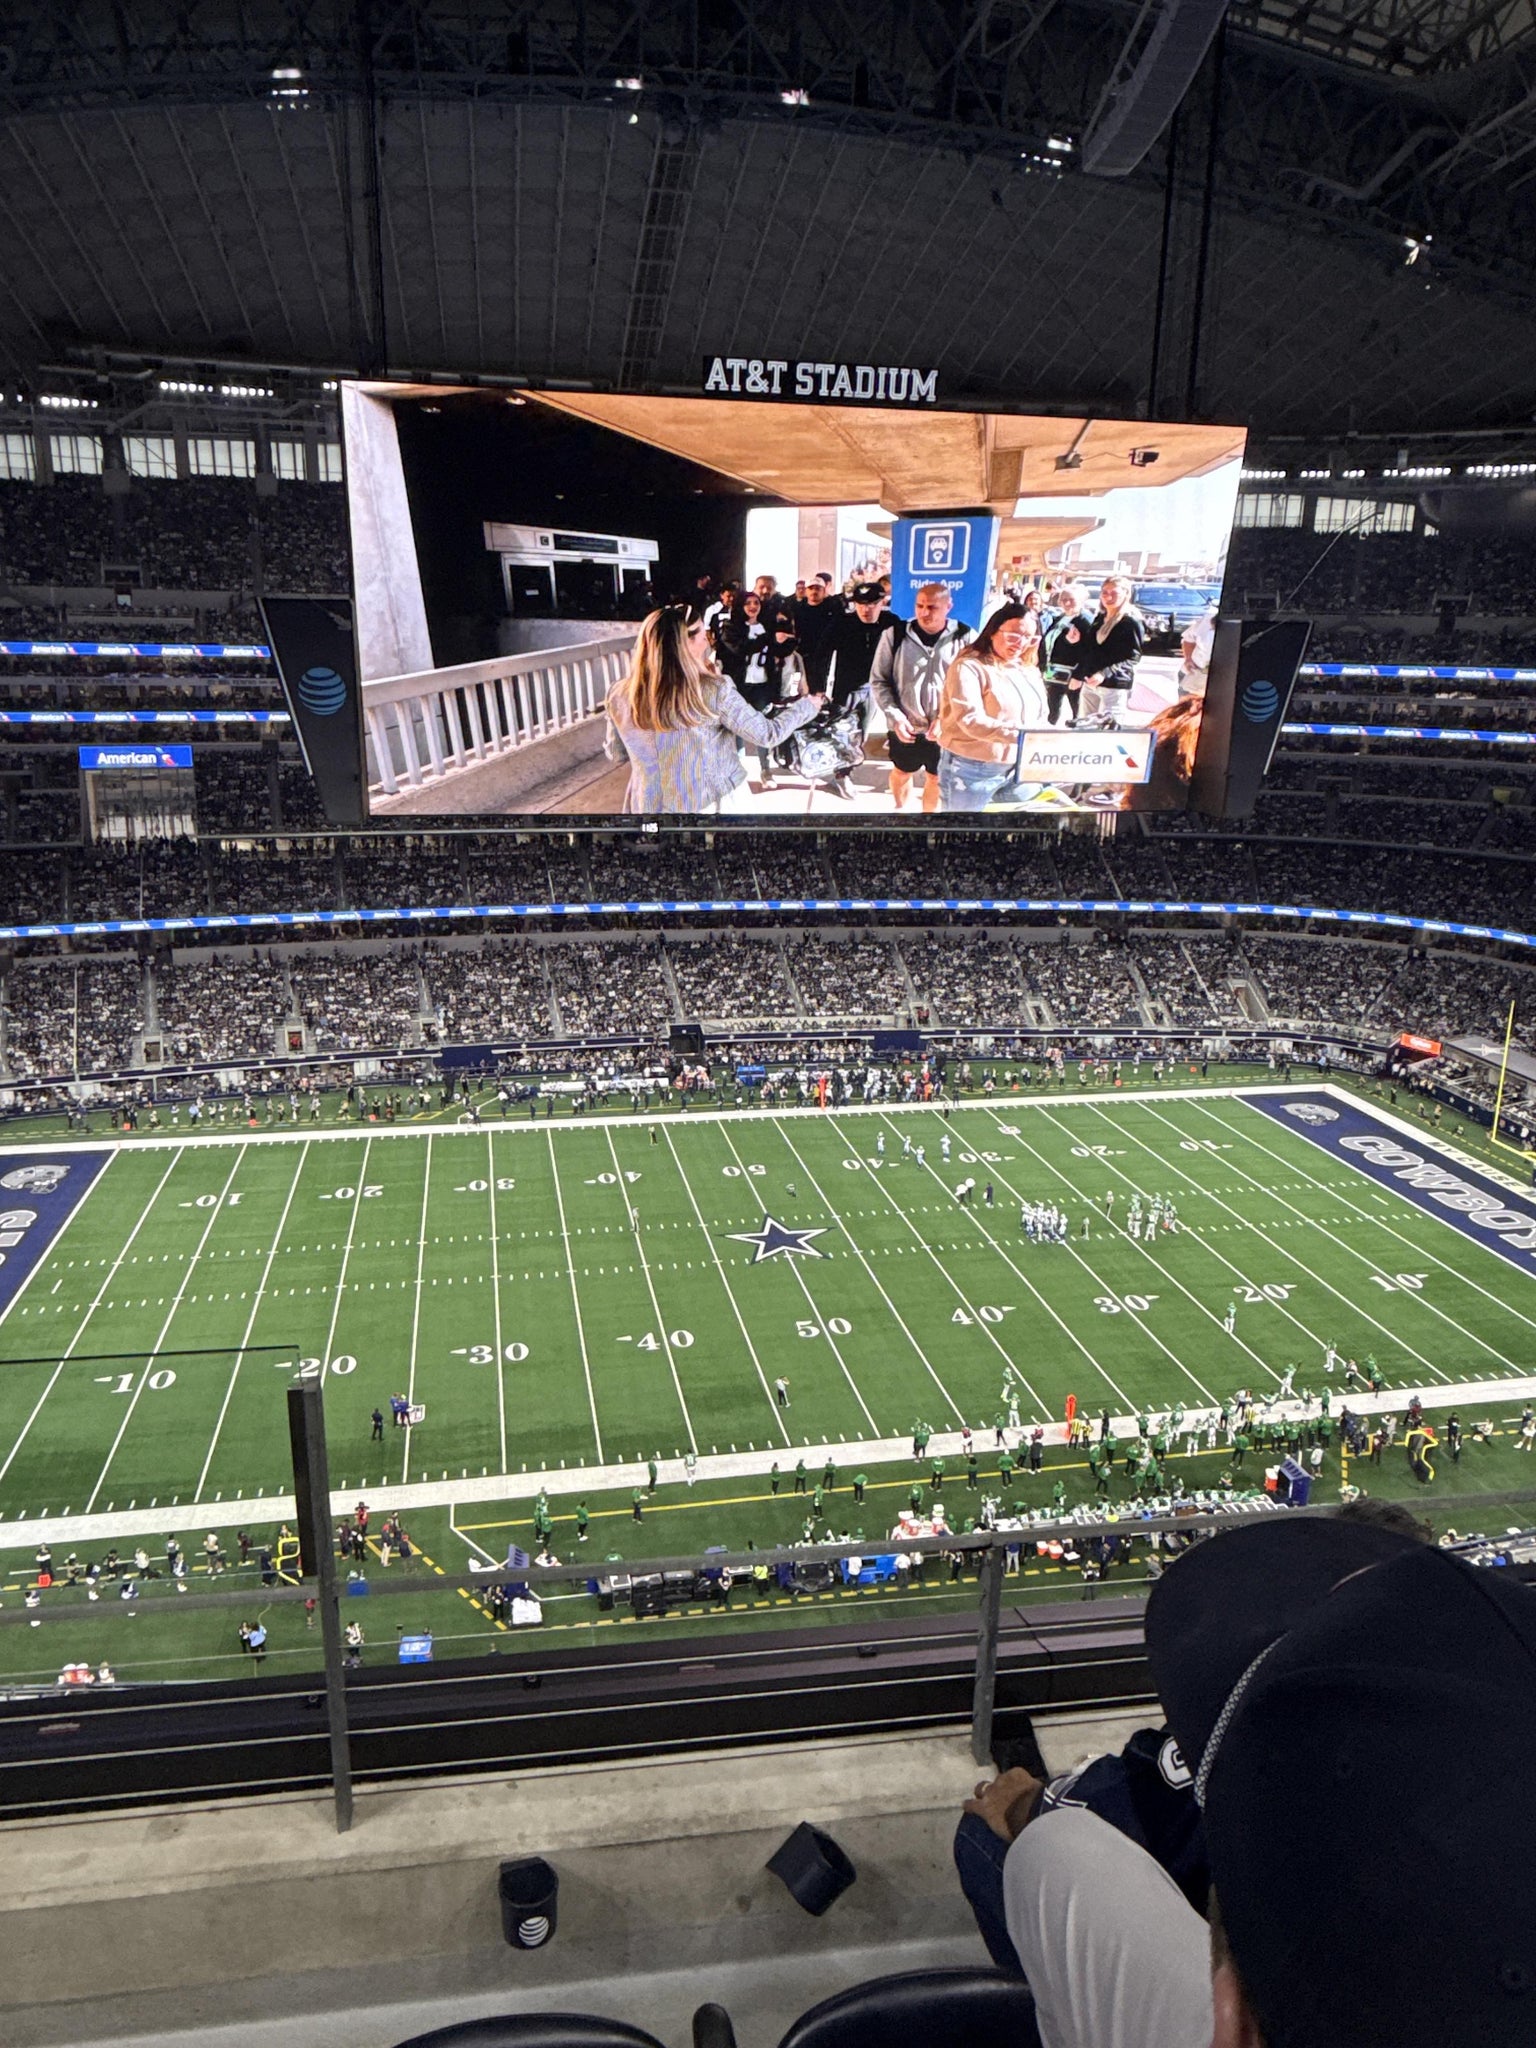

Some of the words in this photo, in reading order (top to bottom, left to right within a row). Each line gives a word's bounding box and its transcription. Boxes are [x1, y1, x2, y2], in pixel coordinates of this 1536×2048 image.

[705, 357, 788, 395] AT&T
[795, 362, 939, 402] STADIUM
[97, 752, 157, 765] American
[1029, 751, 1112, 765] American
[1339, 1136, 1536, 1258] COWBOY
[1232, 1283, 1290, 1303] 20
[1369, 1273, 1424, 1292] 10
[1093, 1294, 1149, 1314] 30
[951, 1305, 1004, 1325] 40
[795, 1317, 852, 1338] 50
[636, 1329, 695, 1351] 40
[469, 1342, 530, 1364] 30
[293, 1355, 357, 1379] 20
[110, 1369, 177, 1394] 10
